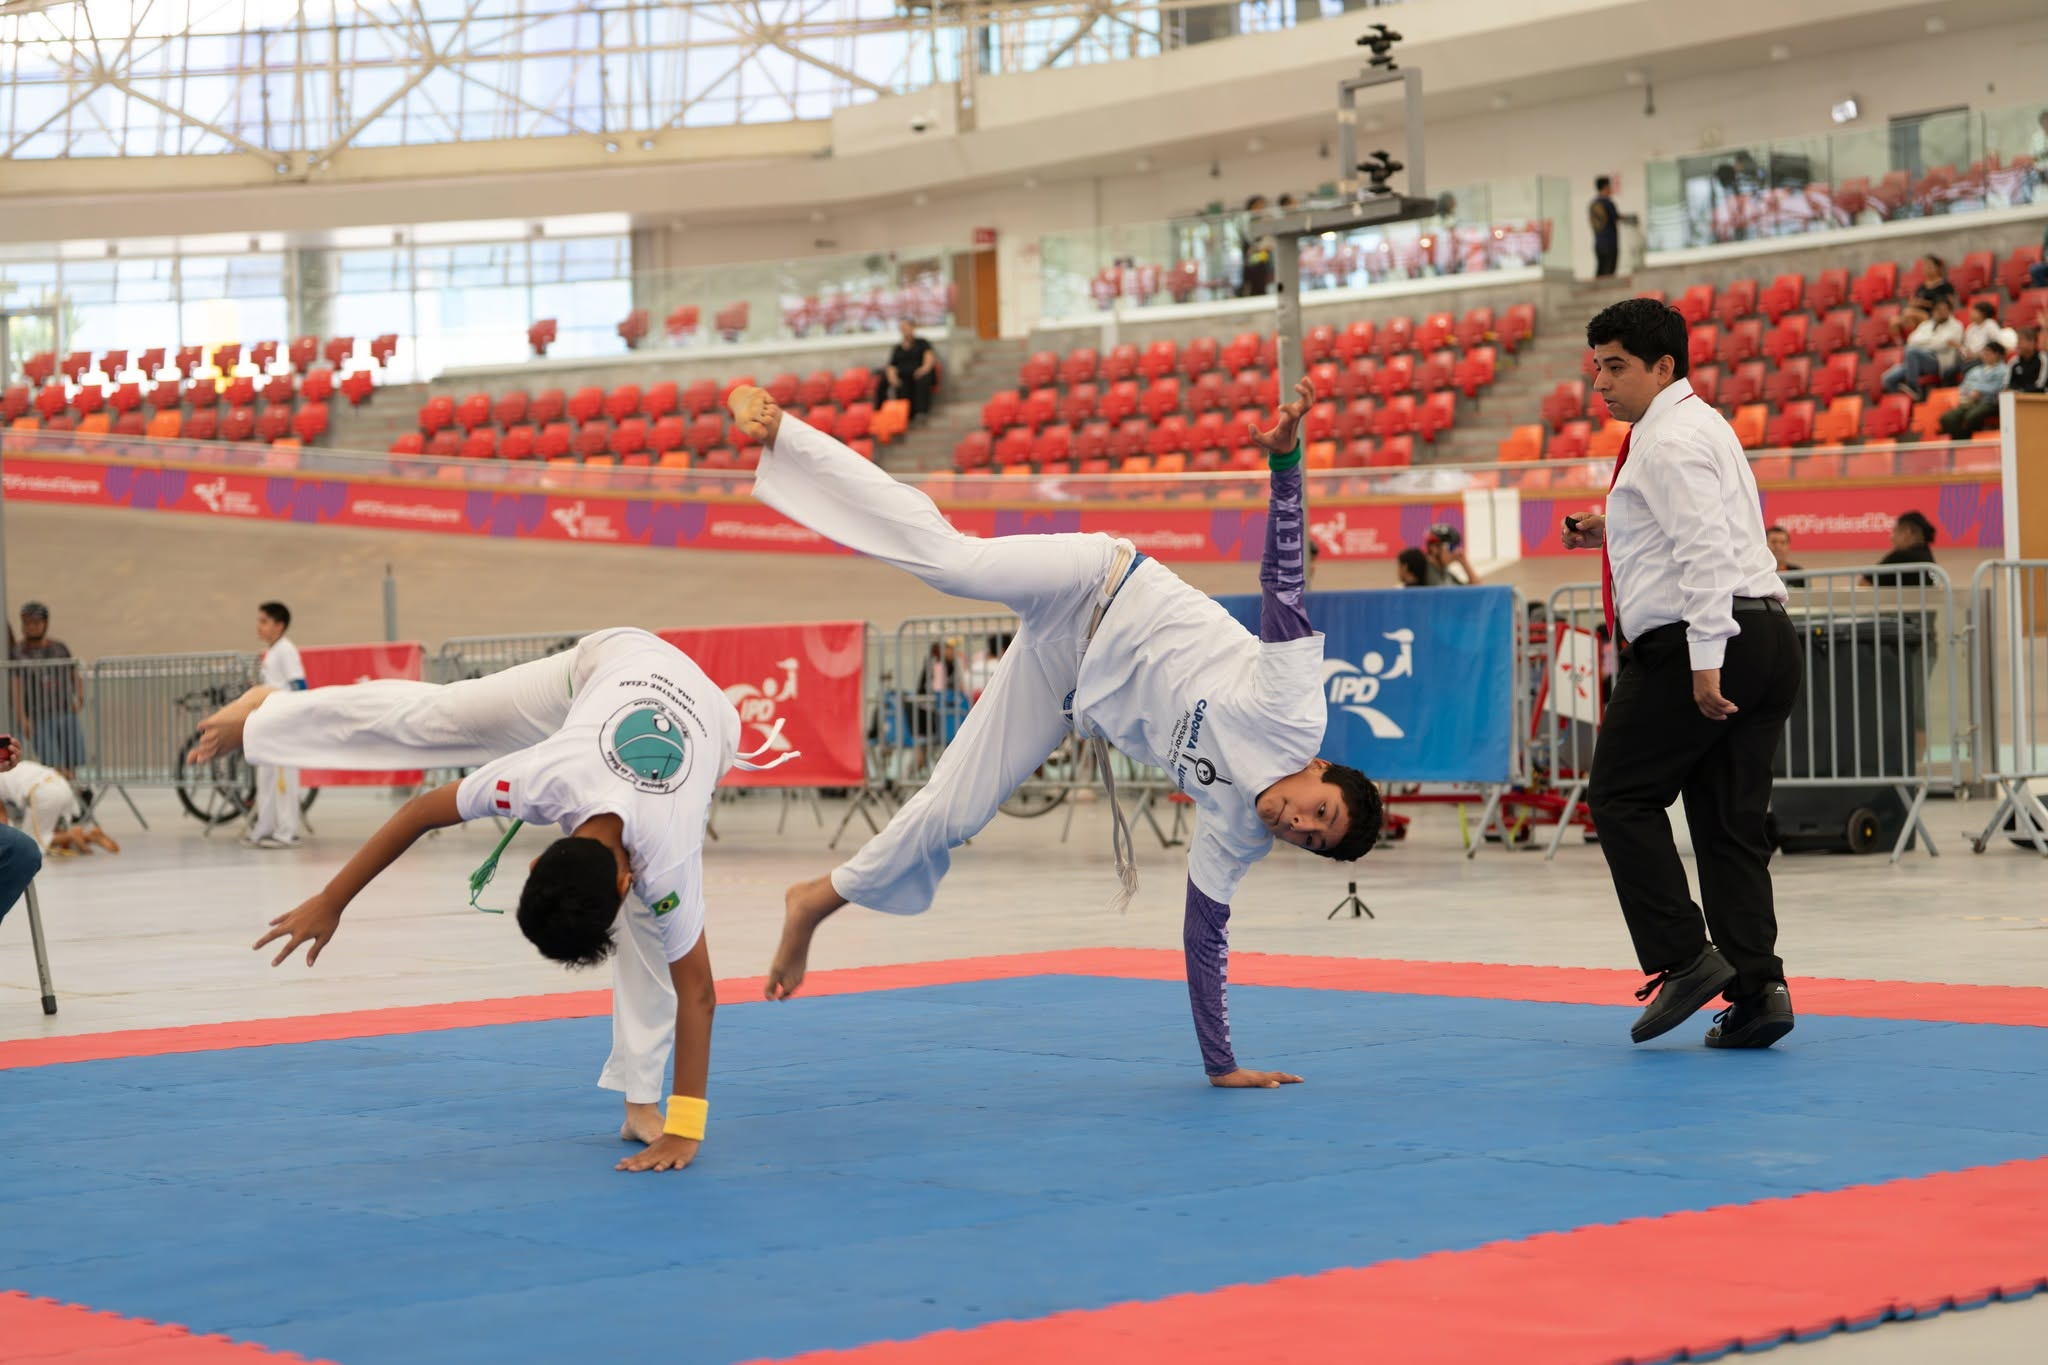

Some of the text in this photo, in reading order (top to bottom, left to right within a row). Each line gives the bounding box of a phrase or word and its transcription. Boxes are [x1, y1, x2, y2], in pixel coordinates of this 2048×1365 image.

[1329, 676, 1380, 704] IPD
[740, 699, 776, 722] IPD
[1186, 699, 1208, 750] CAPOEIRA
